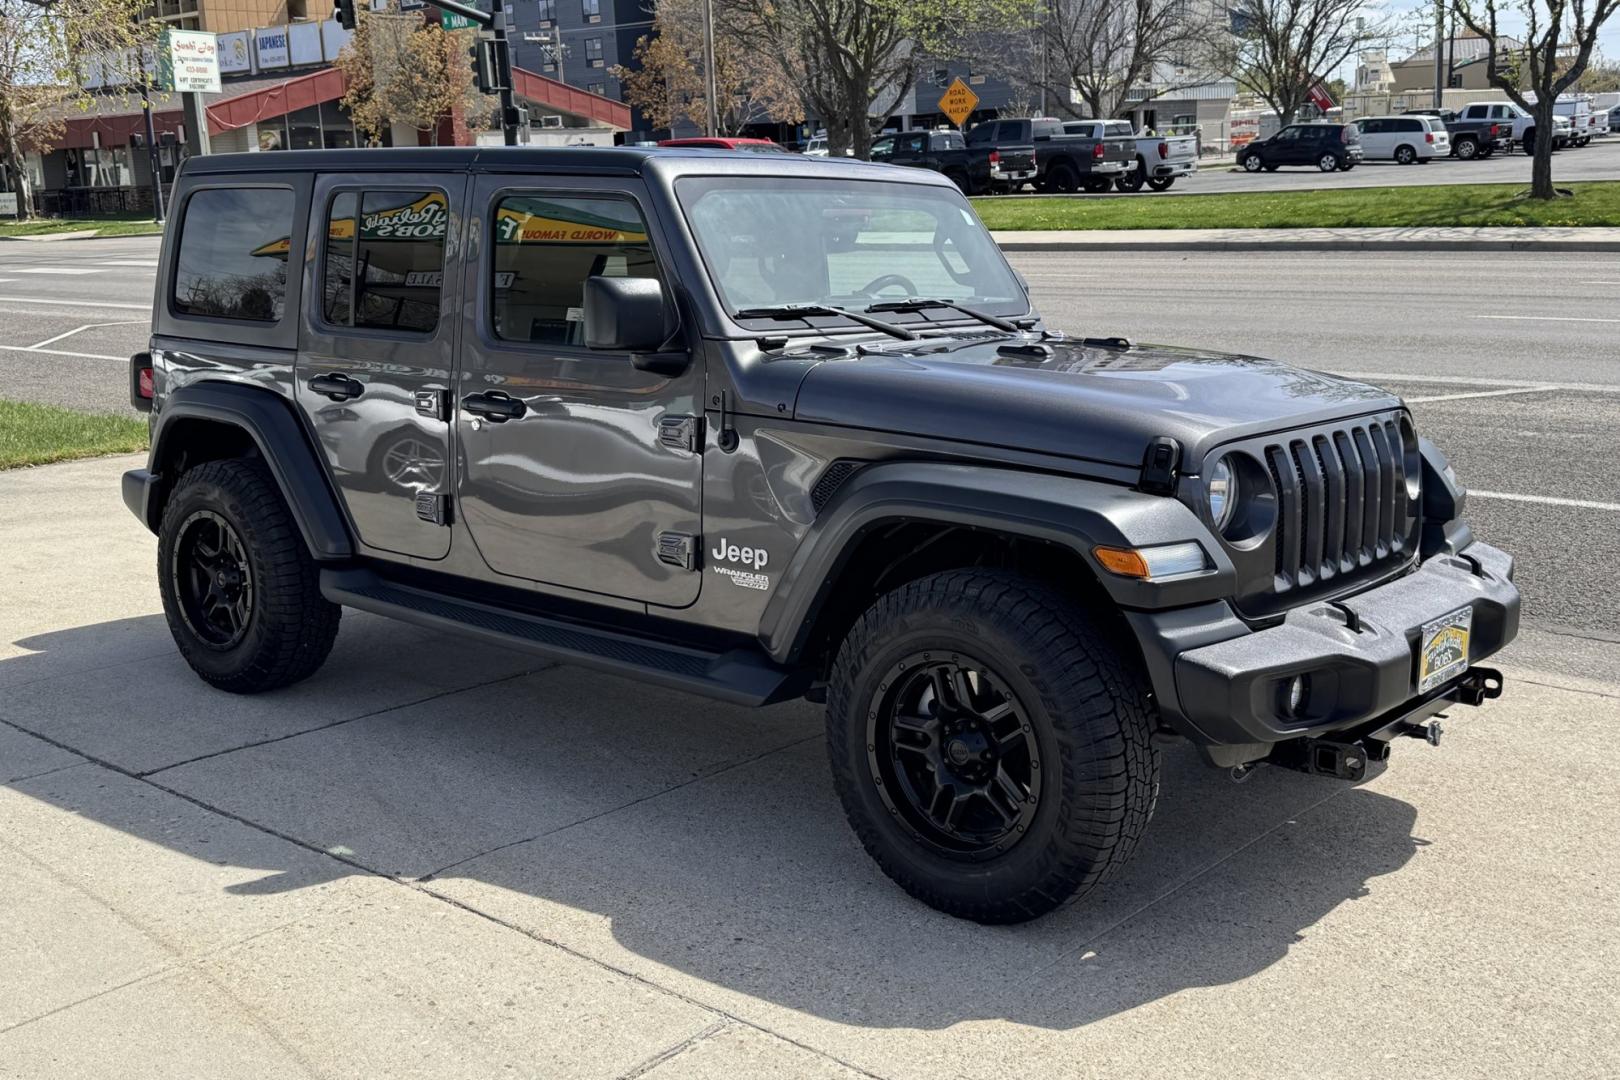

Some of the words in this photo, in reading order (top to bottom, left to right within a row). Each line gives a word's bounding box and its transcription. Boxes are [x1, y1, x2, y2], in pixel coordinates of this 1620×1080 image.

[451, 15, 468, 28] MAIN
[174, 40, 197, 51] Sushi
[198, 41, 214, 54] Joy
[259, 34, 286, 50] JAPANESE
[712, 538, 768, 570] Jeep
[713, 565, 769, 580] WRANGLER
[1017, 662, 1066, 733] OPEN
[1054, 736, 1075, 838] RANGE
